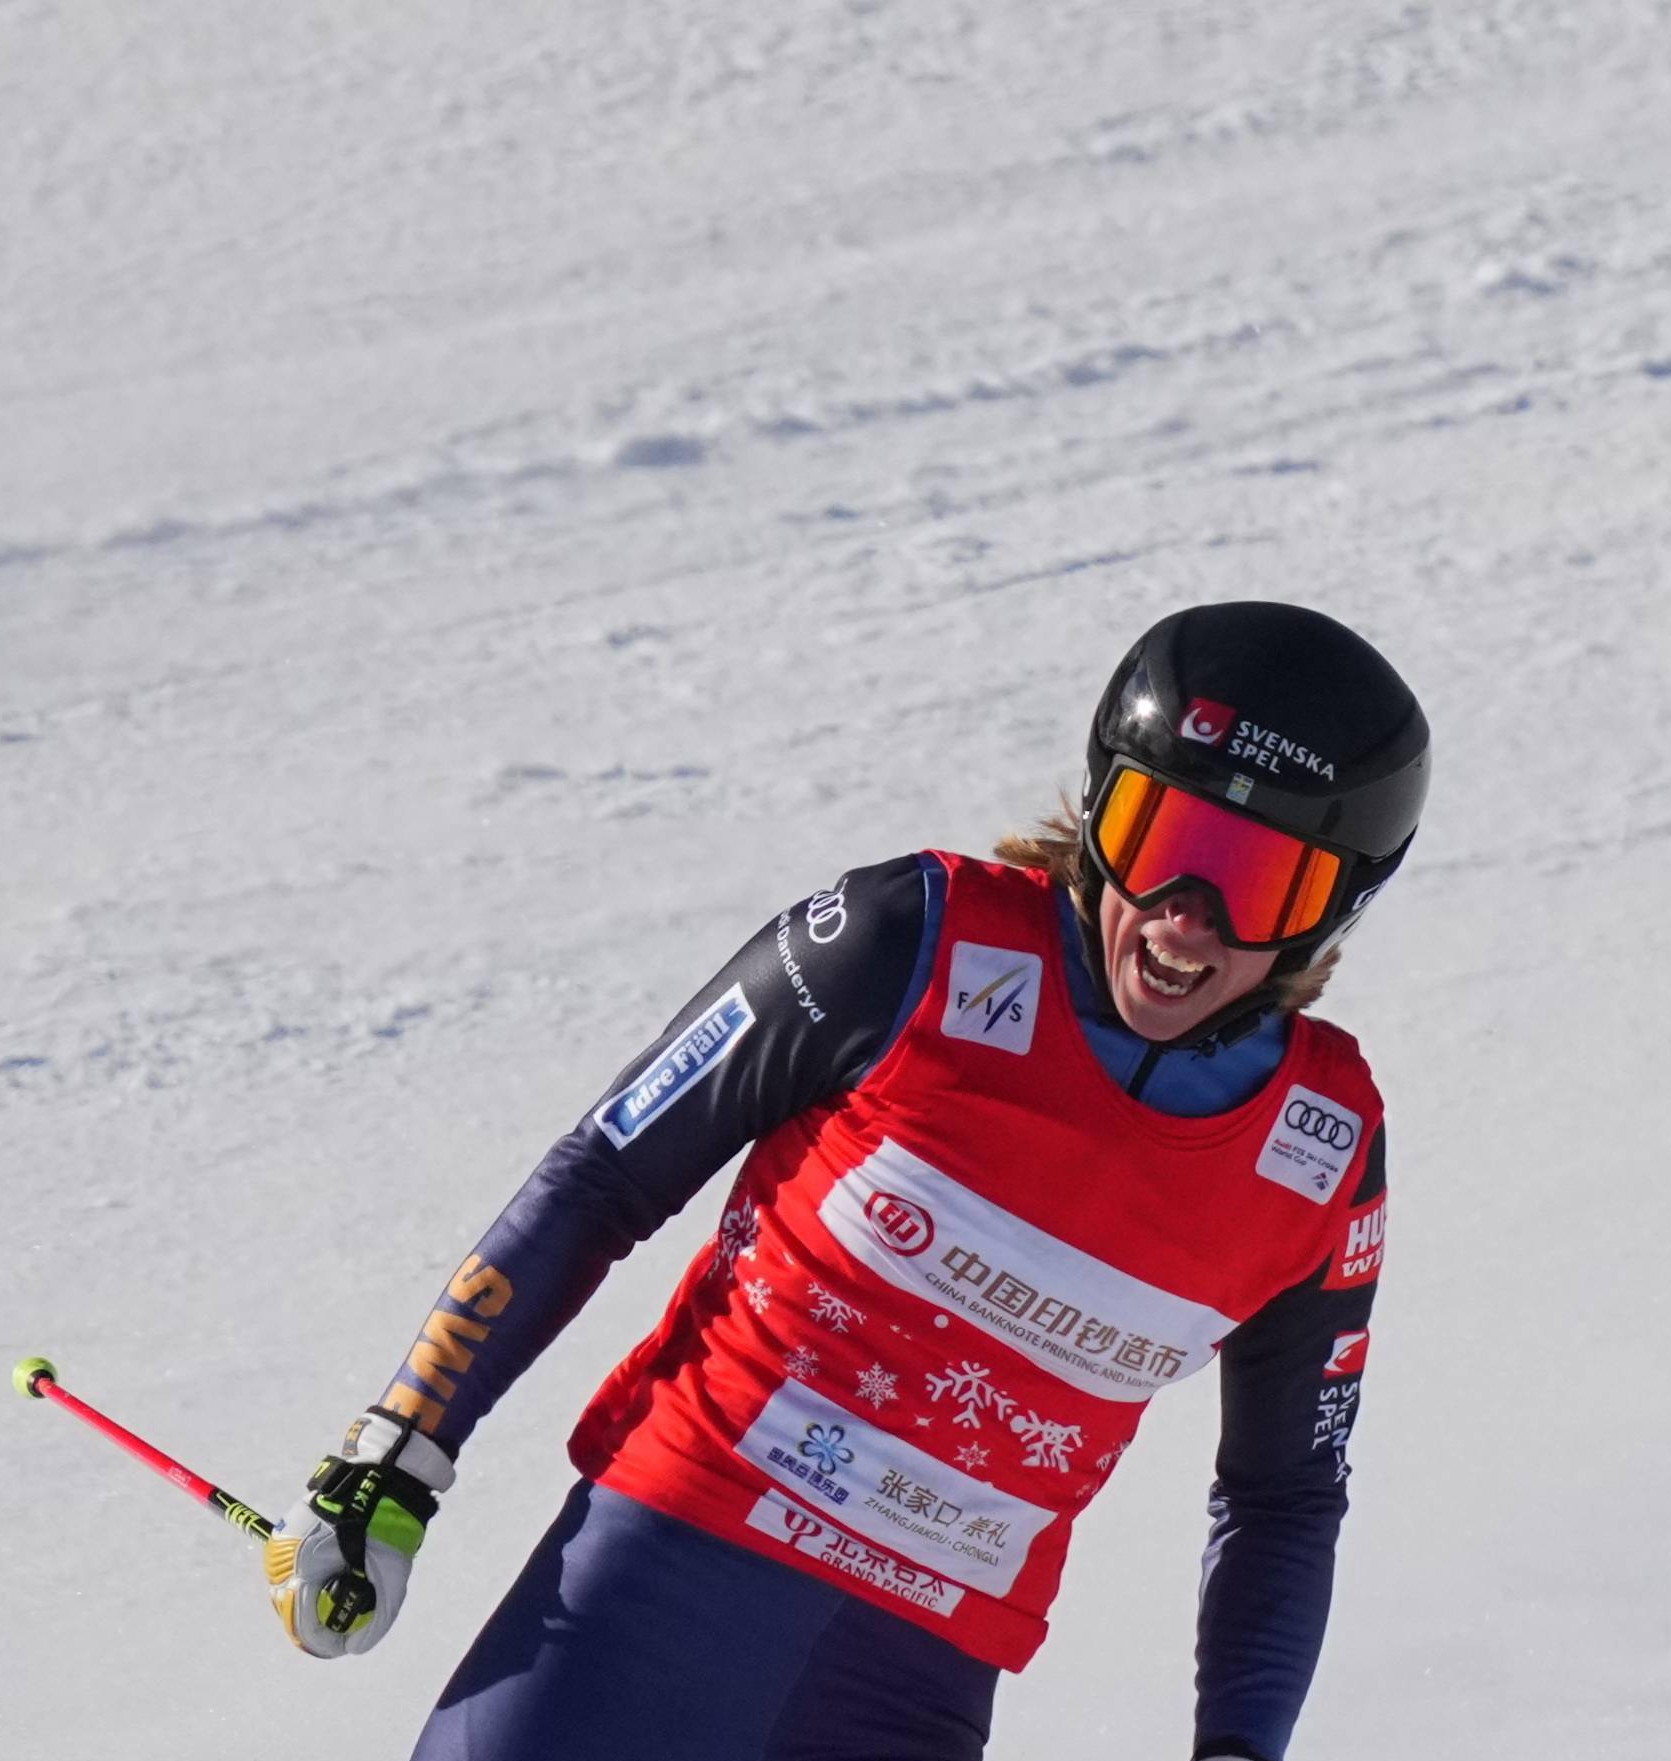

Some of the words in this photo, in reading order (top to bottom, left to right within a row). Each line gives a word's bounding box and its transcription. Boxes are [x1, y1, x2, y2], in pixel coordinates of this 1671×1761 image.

[1228, 739, 1282, 774] SPEL
[1236, 720, 1335, 781] SVENSKA
[776, 925, 827, 1024] Danderyd
[624, 1067, 676, 1118] Idre
[671, 1012, 730, 1074] Fjäll
[925, 1271, 967, 1306] CHINA
[968, 1300, 1039, 1347] BANKNOTE
[1041, 1339, 1101, 1376] PRINTING
[1101, 1368, 1125, 1384] AND
[940, 1246, 1190, 1378] 中国印钞造币
[1312, 1387, 1338, 1450] SPEL
[351, 1470, 382, 1513] LEKI
[820, 1551, 877, 1585] GRAND
[882, 1578, 940, 1610] PACIFIC
